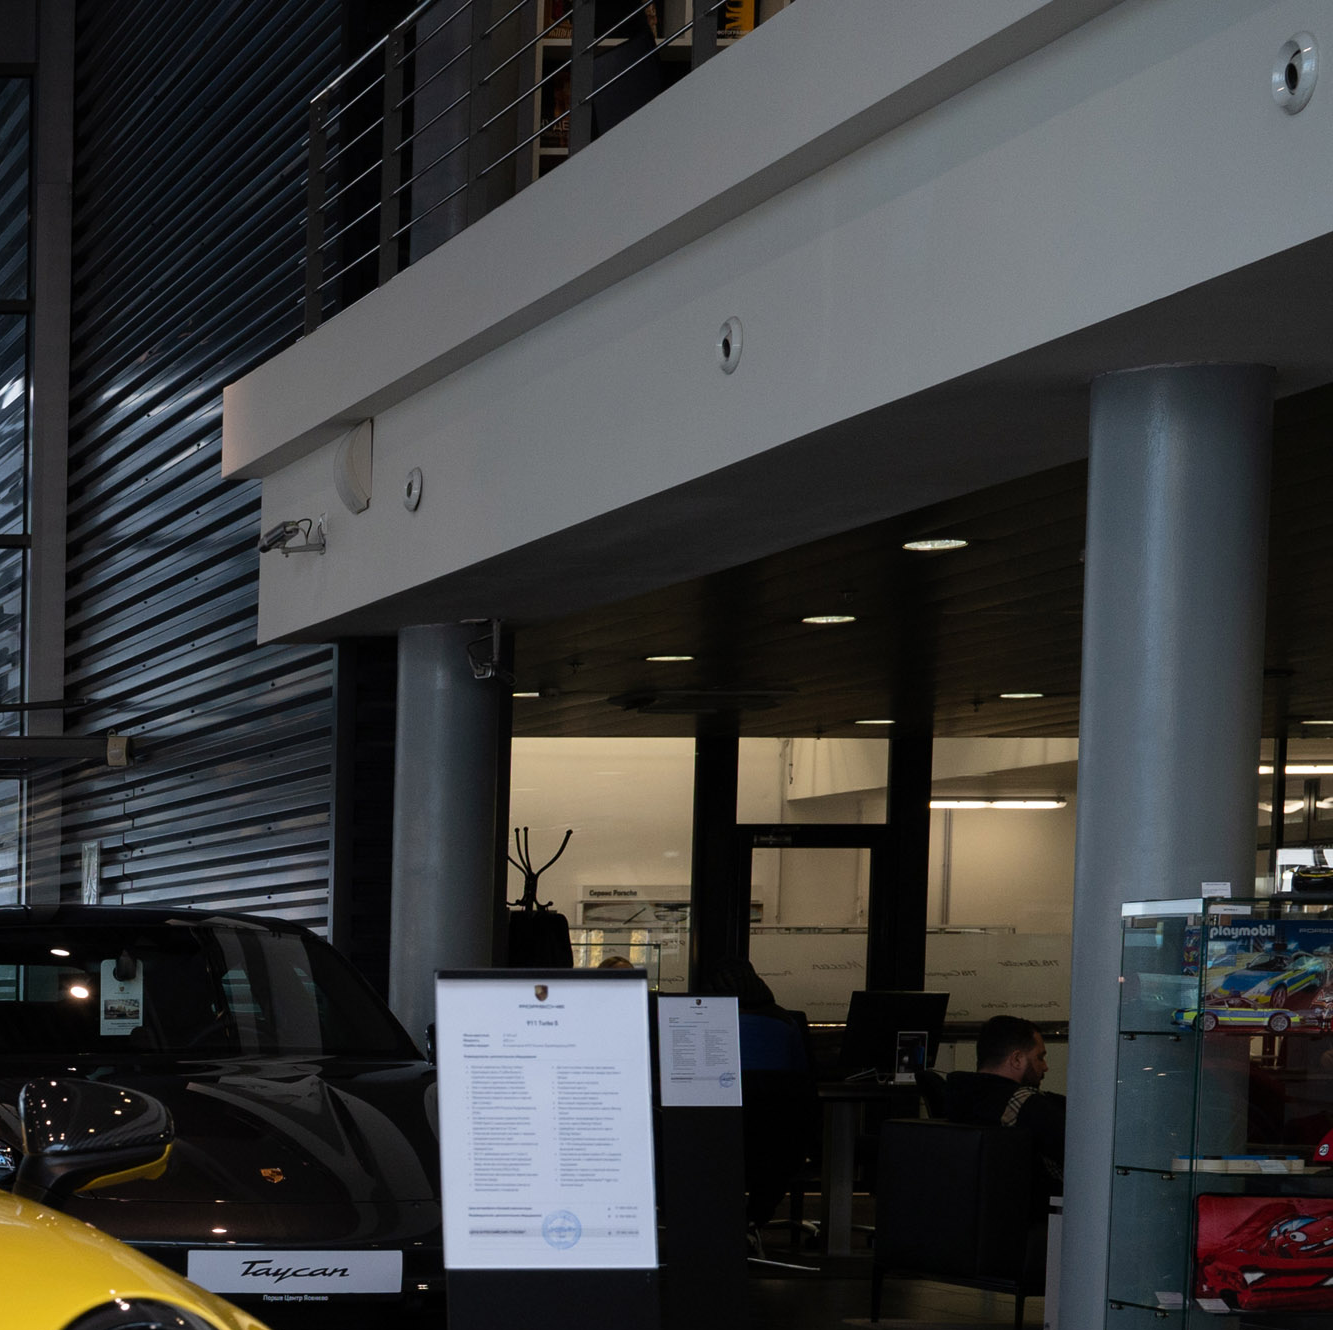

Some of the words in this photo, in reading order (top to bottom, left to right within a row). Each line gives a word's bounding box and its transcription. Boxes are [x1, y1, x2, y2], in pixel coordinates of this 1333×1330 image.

[589, 889, 612, 897] Сервис
[1210, 924, 1275, 939] playmobil
[241, 1259, 350, 1284] Taycan
[263, 1294, 283, 1302] Порше
[284, 1294, 303, 1302] Центр
[303, 1294, 329, 1302] Ясенево
